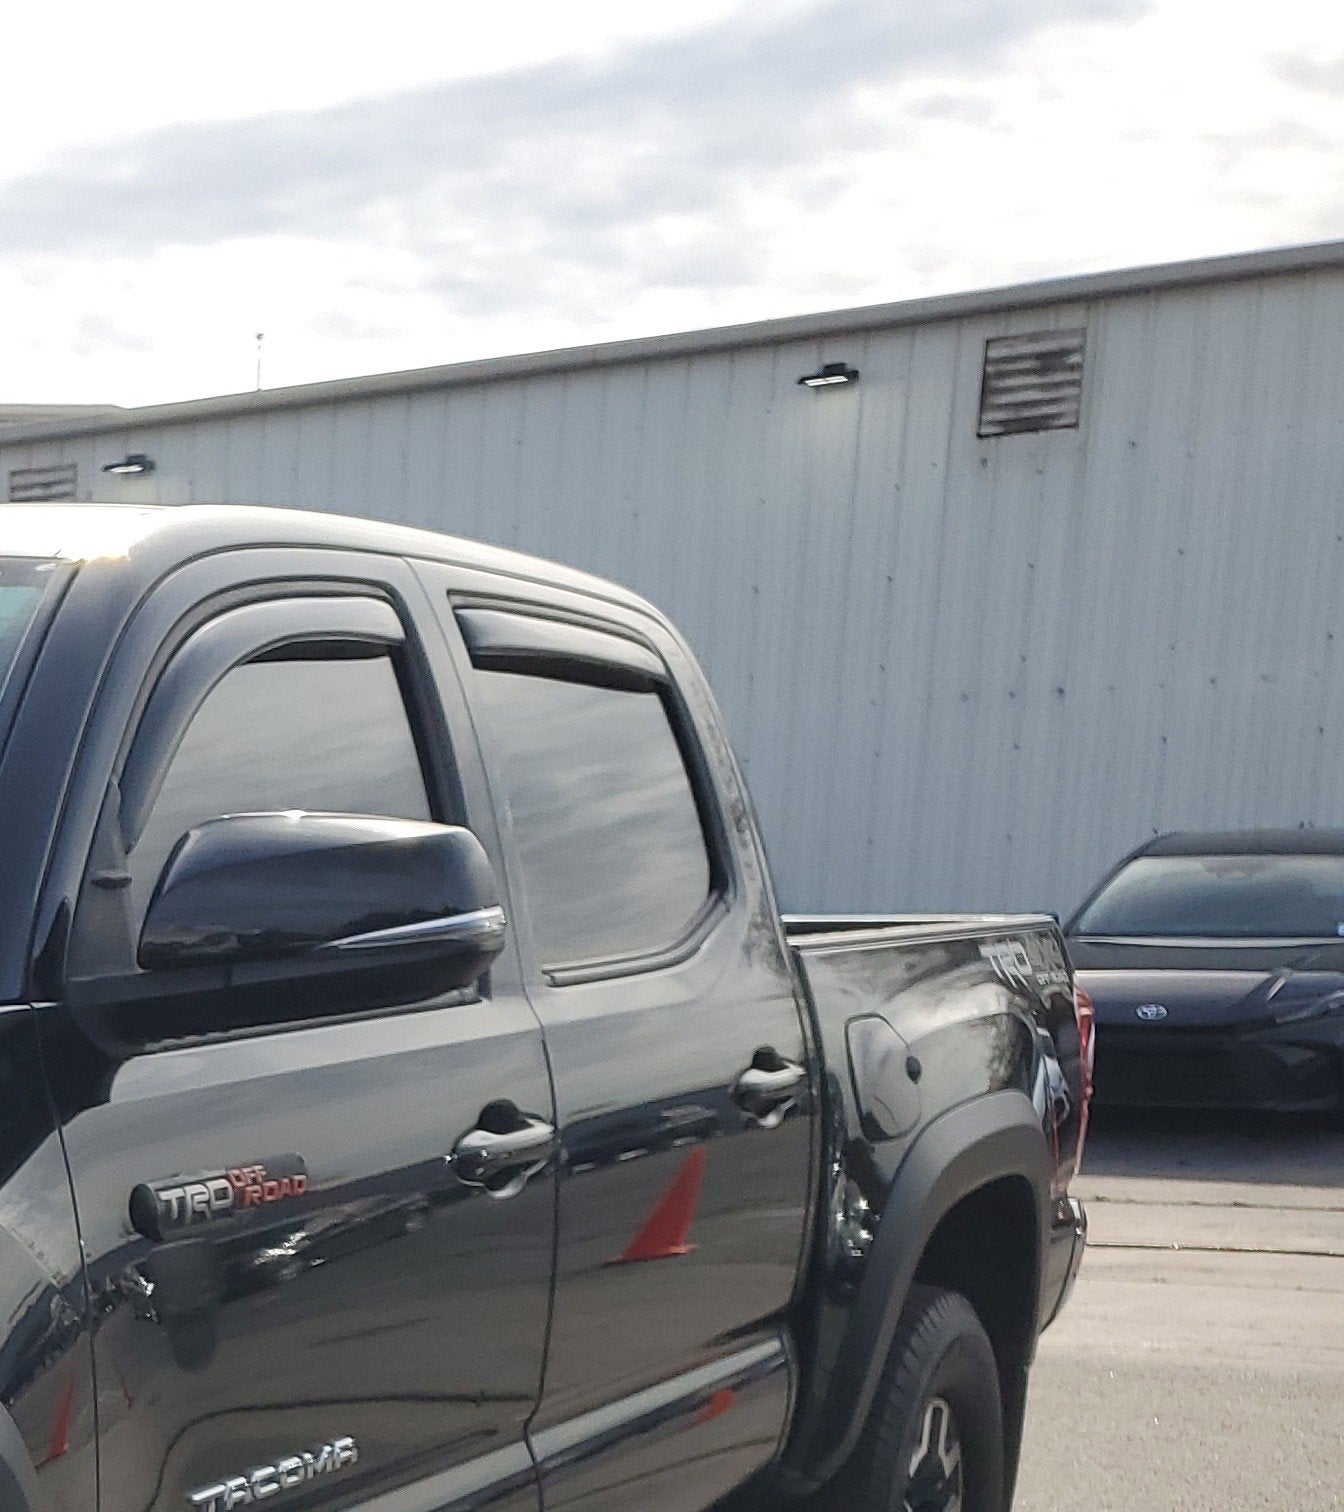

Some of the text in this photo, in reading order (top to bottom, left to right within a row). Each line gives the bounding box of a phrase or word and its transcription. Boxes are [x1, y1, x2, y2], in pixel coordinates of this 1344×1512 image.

[978, 940, 1032, 988] TRD
[228, 1164, 267, 1188] OFF
[242, 1174, 308, 1207] ROAD
[157, 1178, 234, 1224] TRD
